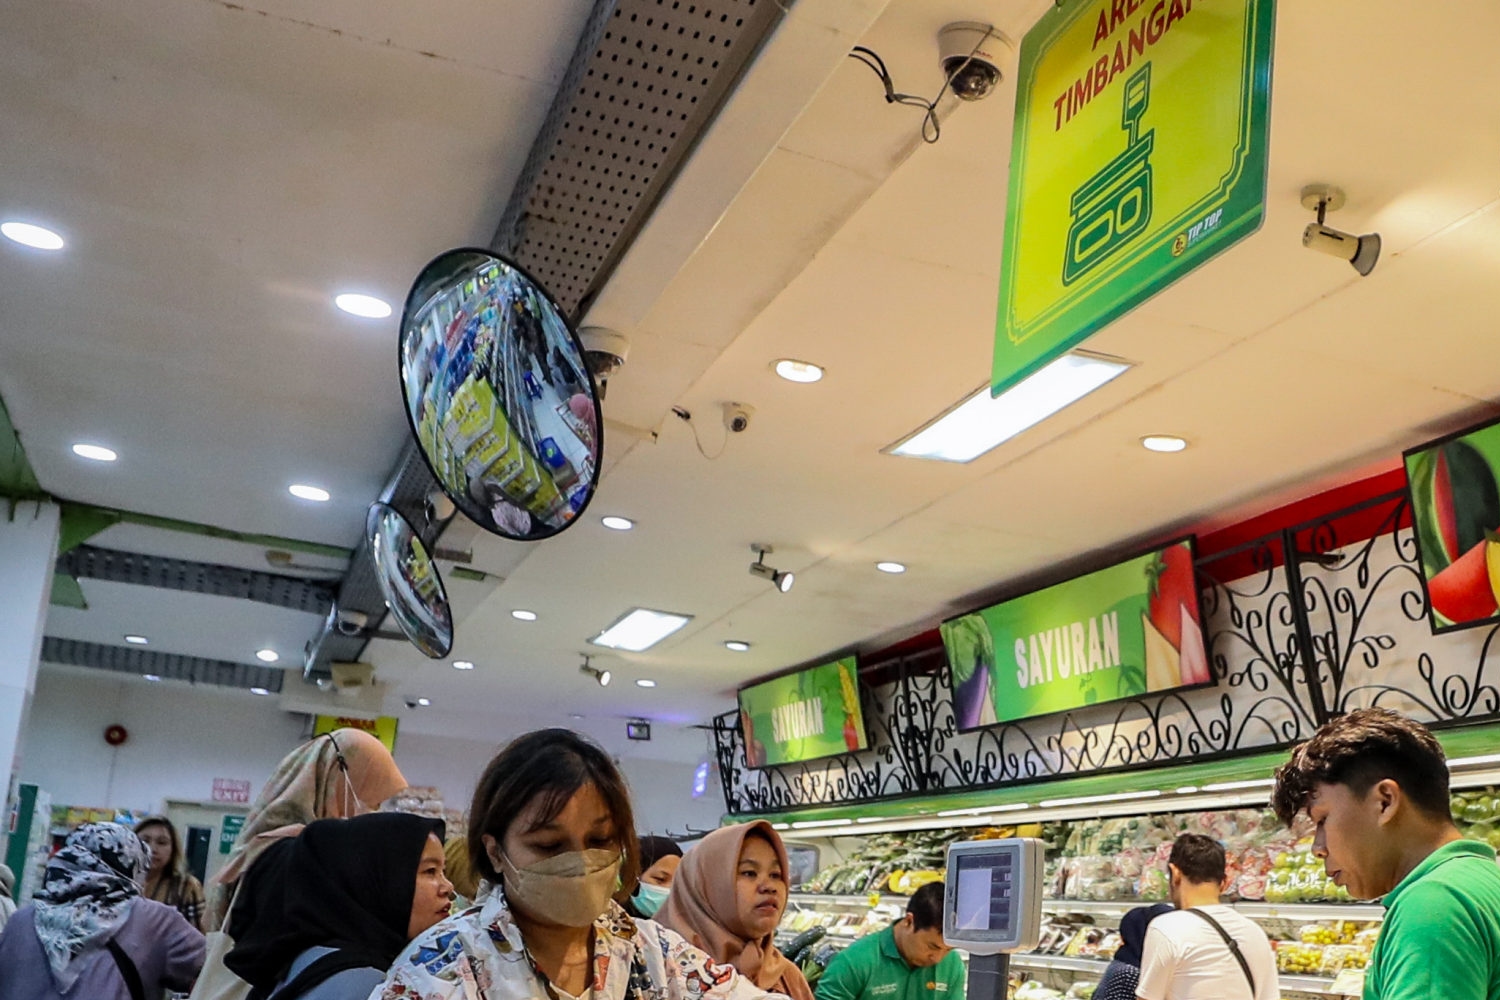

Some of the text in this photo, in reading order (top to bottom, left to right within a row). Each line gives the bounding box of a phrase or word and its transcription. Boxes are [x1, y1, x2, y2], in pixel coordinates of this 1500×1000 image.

[1054, 0, 1192, 132] TIMBANGA
[1188, 221, 1204, 242] TIP
[1204, 208, 1223, 230] TOP
[1014, 611, 1120, 689] SAYURAN
[772, 696, 825, 744] SAYURAN
